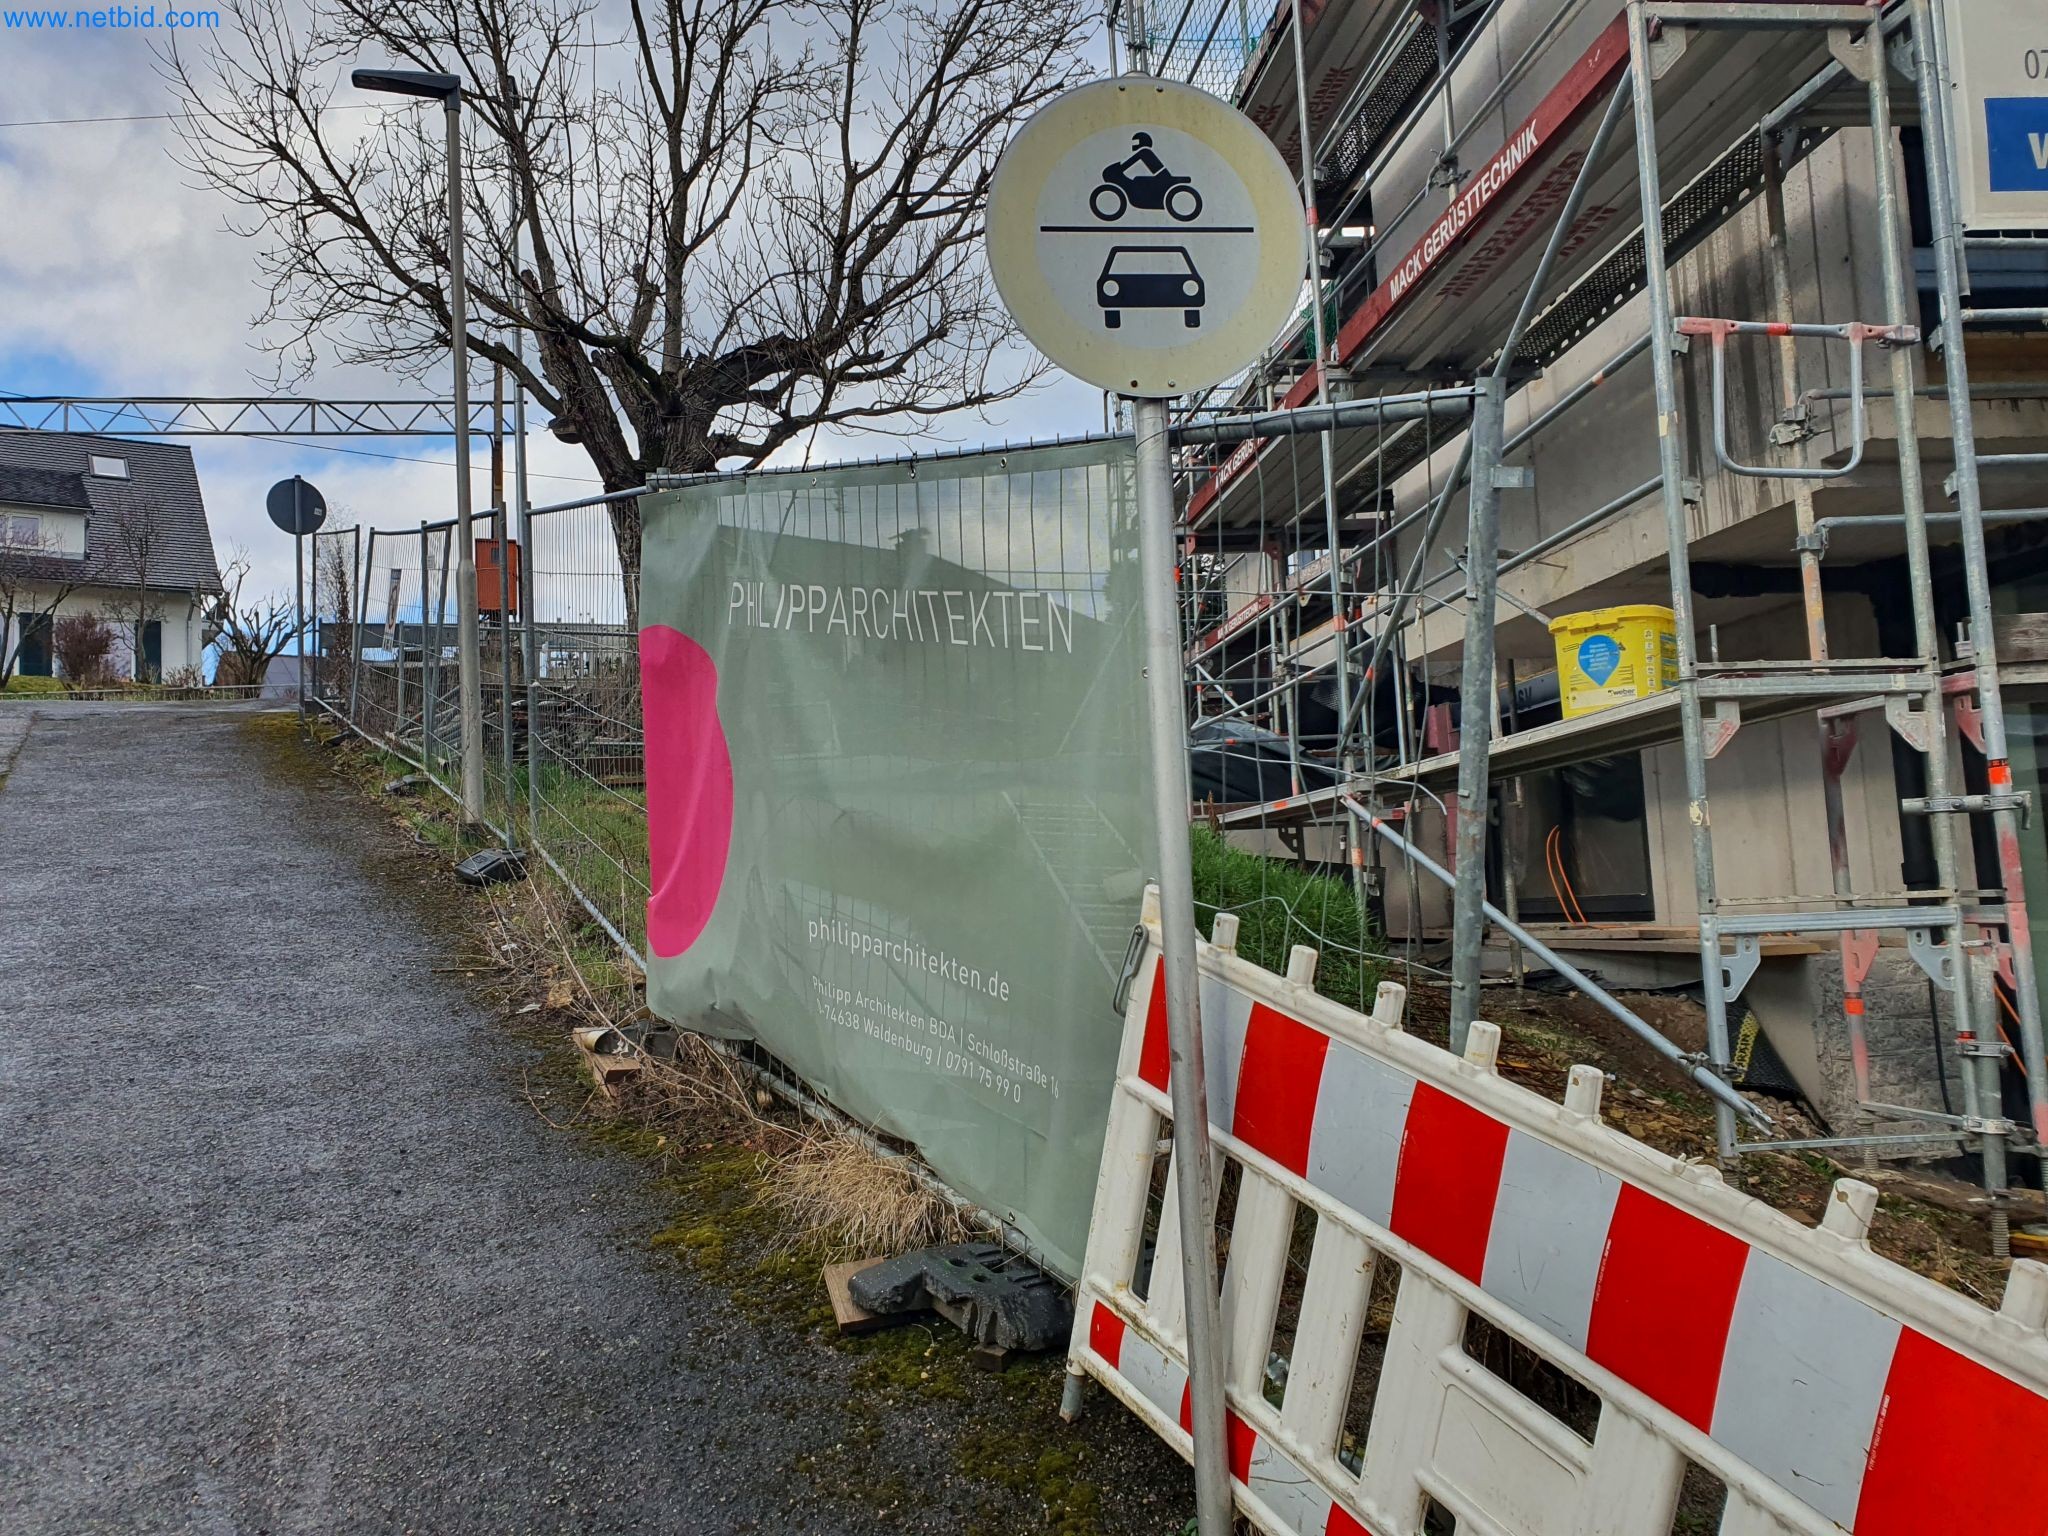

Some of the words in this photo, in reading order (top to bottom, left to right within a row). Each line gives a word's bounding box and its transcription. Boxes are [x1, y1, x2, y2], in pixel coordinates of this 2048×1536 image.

[1390, 249, 1422, 301] MACK
[1424, 119, 1539, 263] GERÜSTTECHNIK
[728, 581, 1072, 653] PHILIPPARCHITEKTEN
[808, 917, 1009, 1001] philipparchitekten.de
[812, 975, 851, 1006] Philipp
[855, 990, 925, 1031] Architekten
[930, 1017, 956, 1044] BDA
[968, 1033, 1047, 1088] Schloßstraße
[1051, 1075, 1059, 1099] 16
[863, 1017, 932, 1065] Waldenburg
[946, 1051, 974, 1079] 0791
[979, 1066, 992, 1088] 75
[997, 1076, 1009, 1097] 99
[1014, 1084, 1021, 1103] 0
